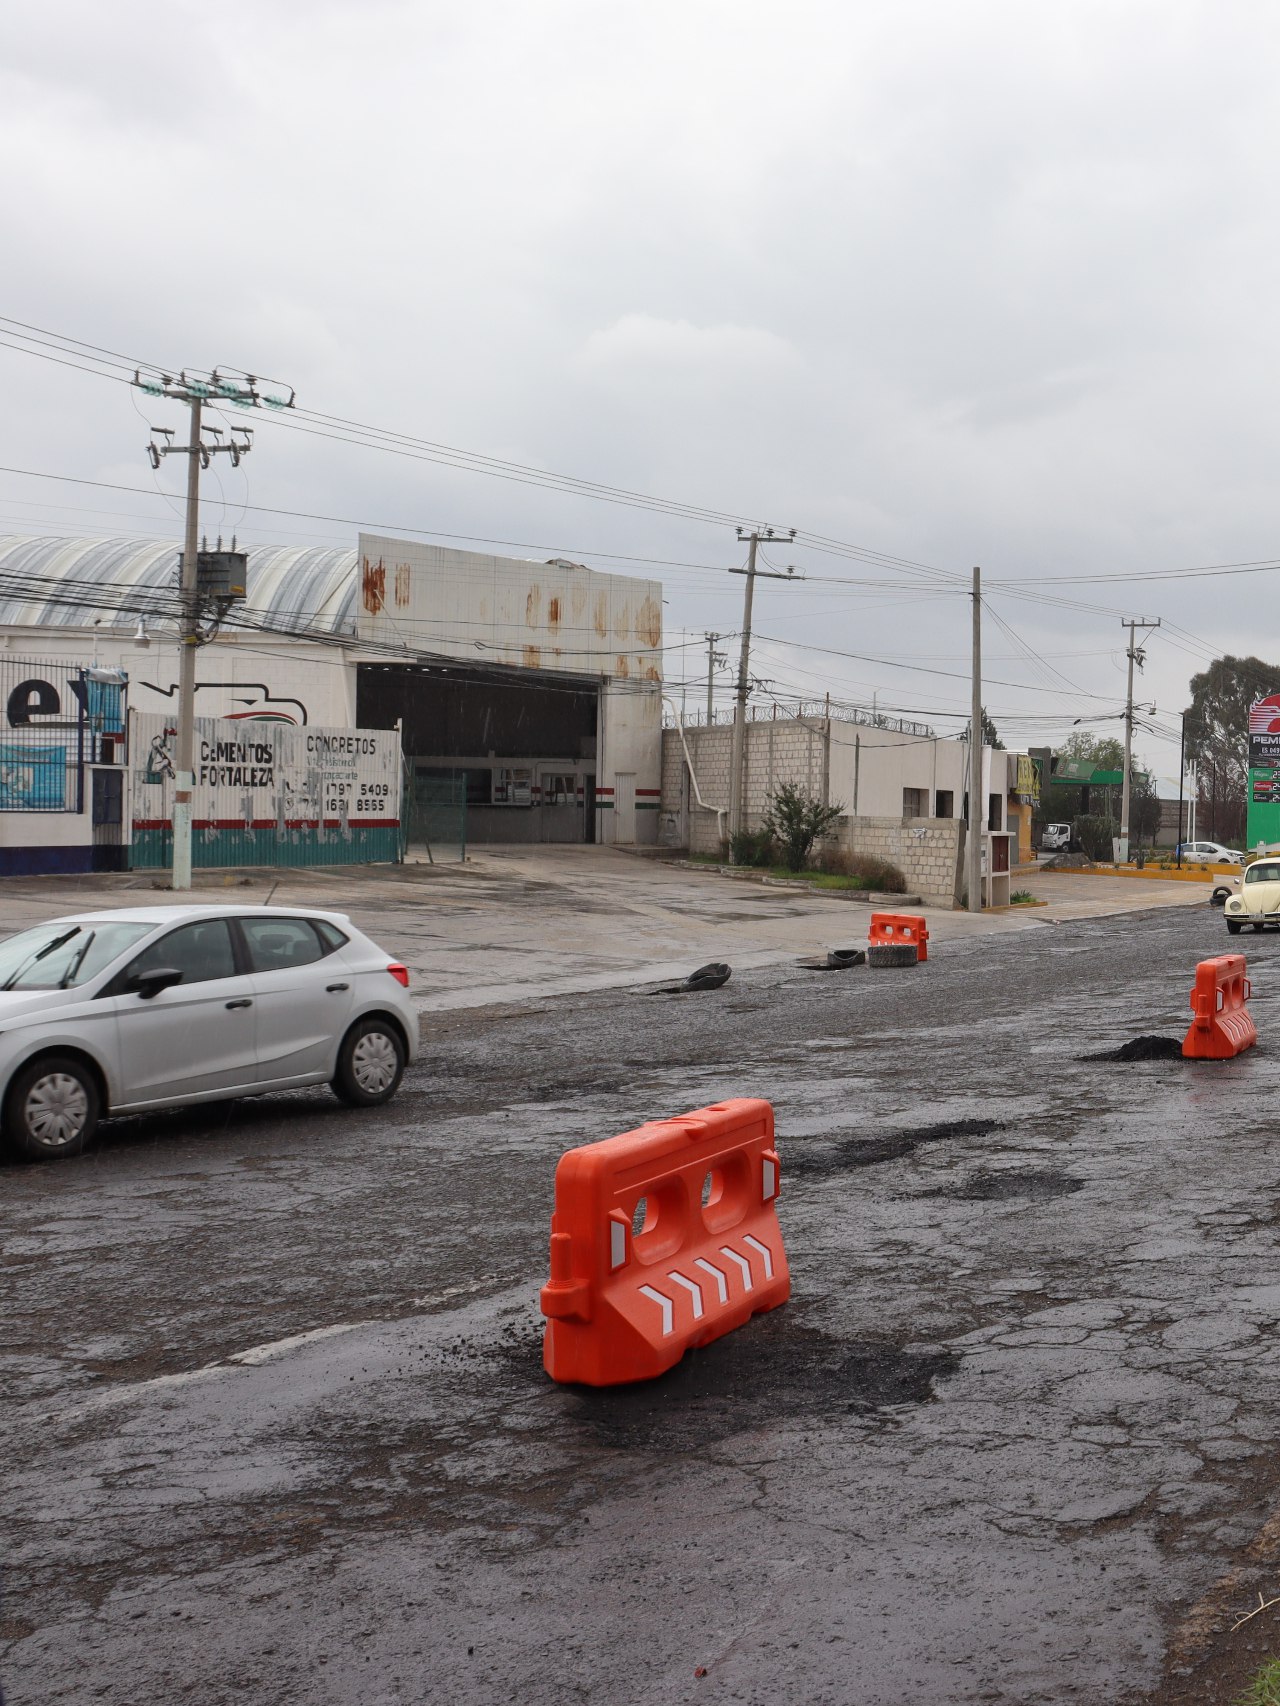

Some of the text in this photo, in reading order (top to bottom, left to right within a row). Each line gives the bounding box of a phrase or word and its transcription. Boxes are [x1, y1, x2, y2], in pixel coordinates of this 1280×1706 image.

[201, 741, 273, 764] CEMENTOS
[306, 735, 376, 755] CONCRETOS
[200, 765, 275, 788] FORTALEZA
[326, 783, 352, 796] 1797
[361, 784, 389, 797] 5409
